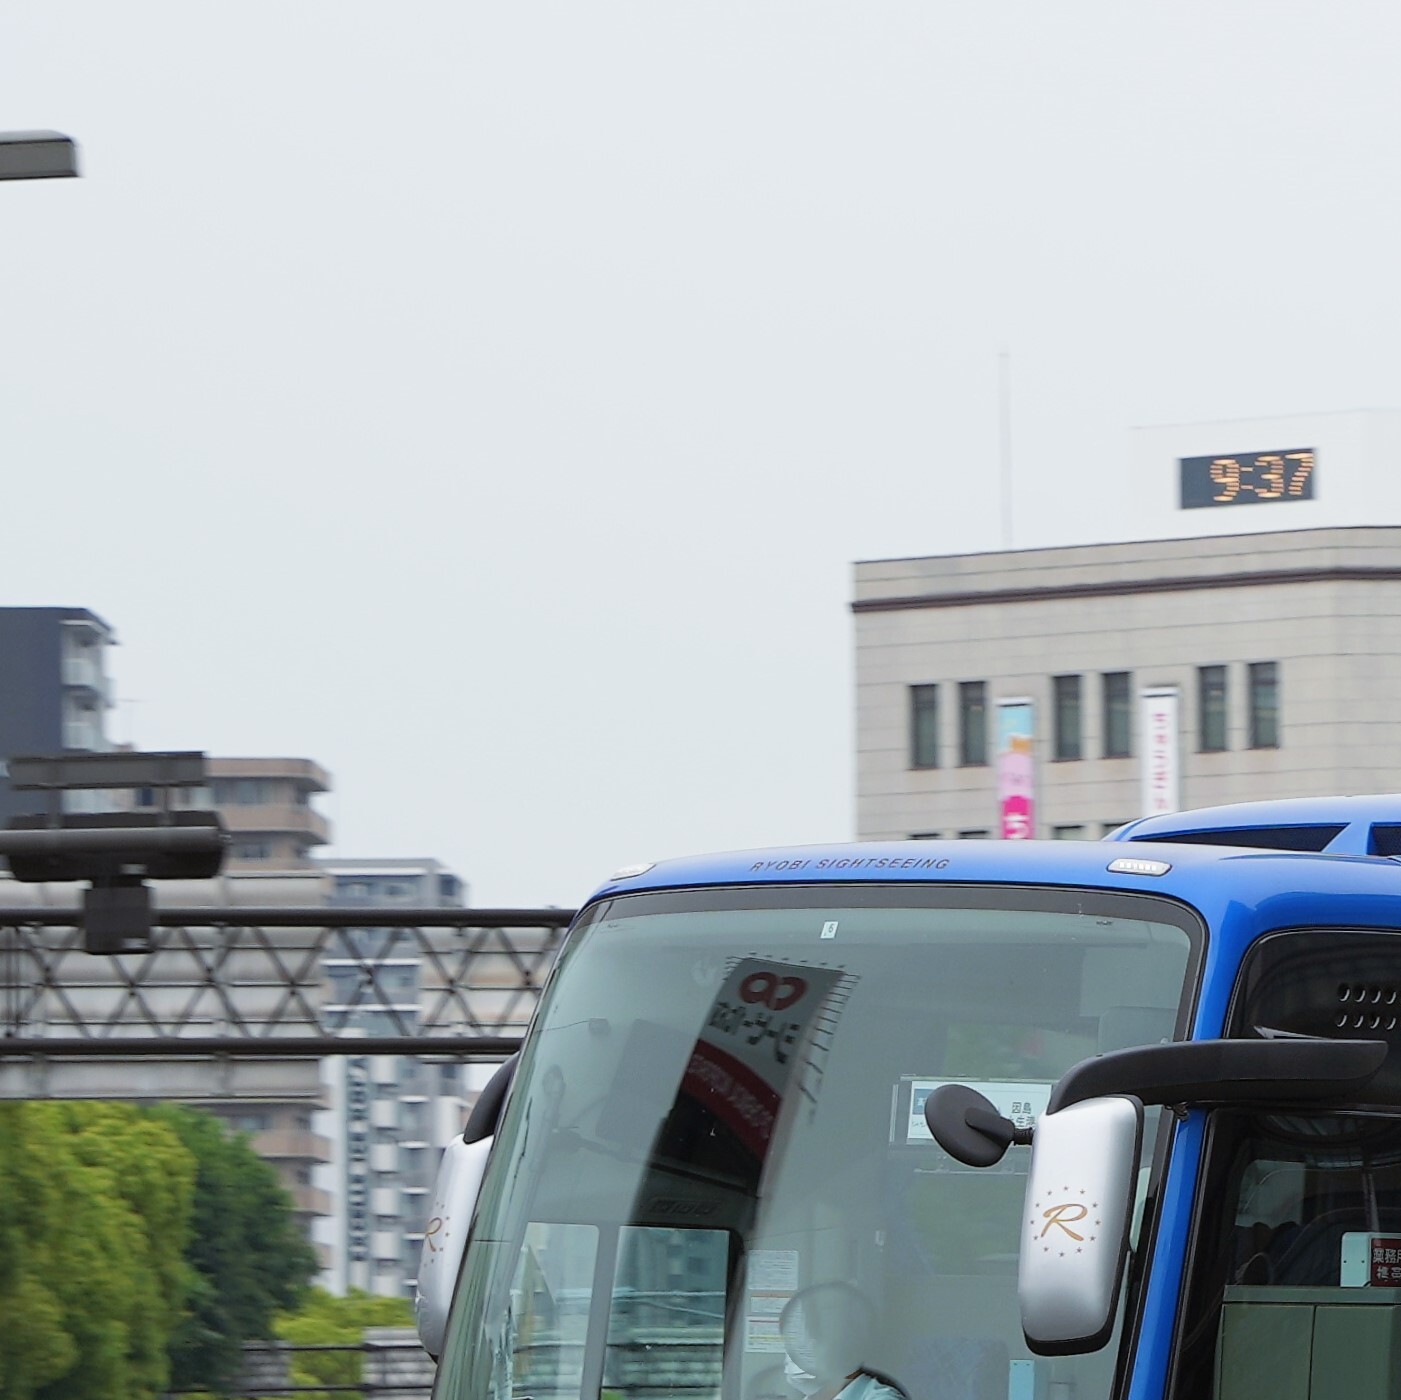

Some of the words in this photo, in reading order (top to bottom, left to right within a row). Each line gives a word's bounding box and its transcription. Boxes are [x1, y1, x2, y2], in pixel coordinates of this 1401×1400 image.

[1209, 452, 1315, 502] 9:37
[749, 859, 811, 872] RYOBI
[816, 857, 950, 870] SIGHTSEEING
[1041, 1203, 1088, 1242] R
